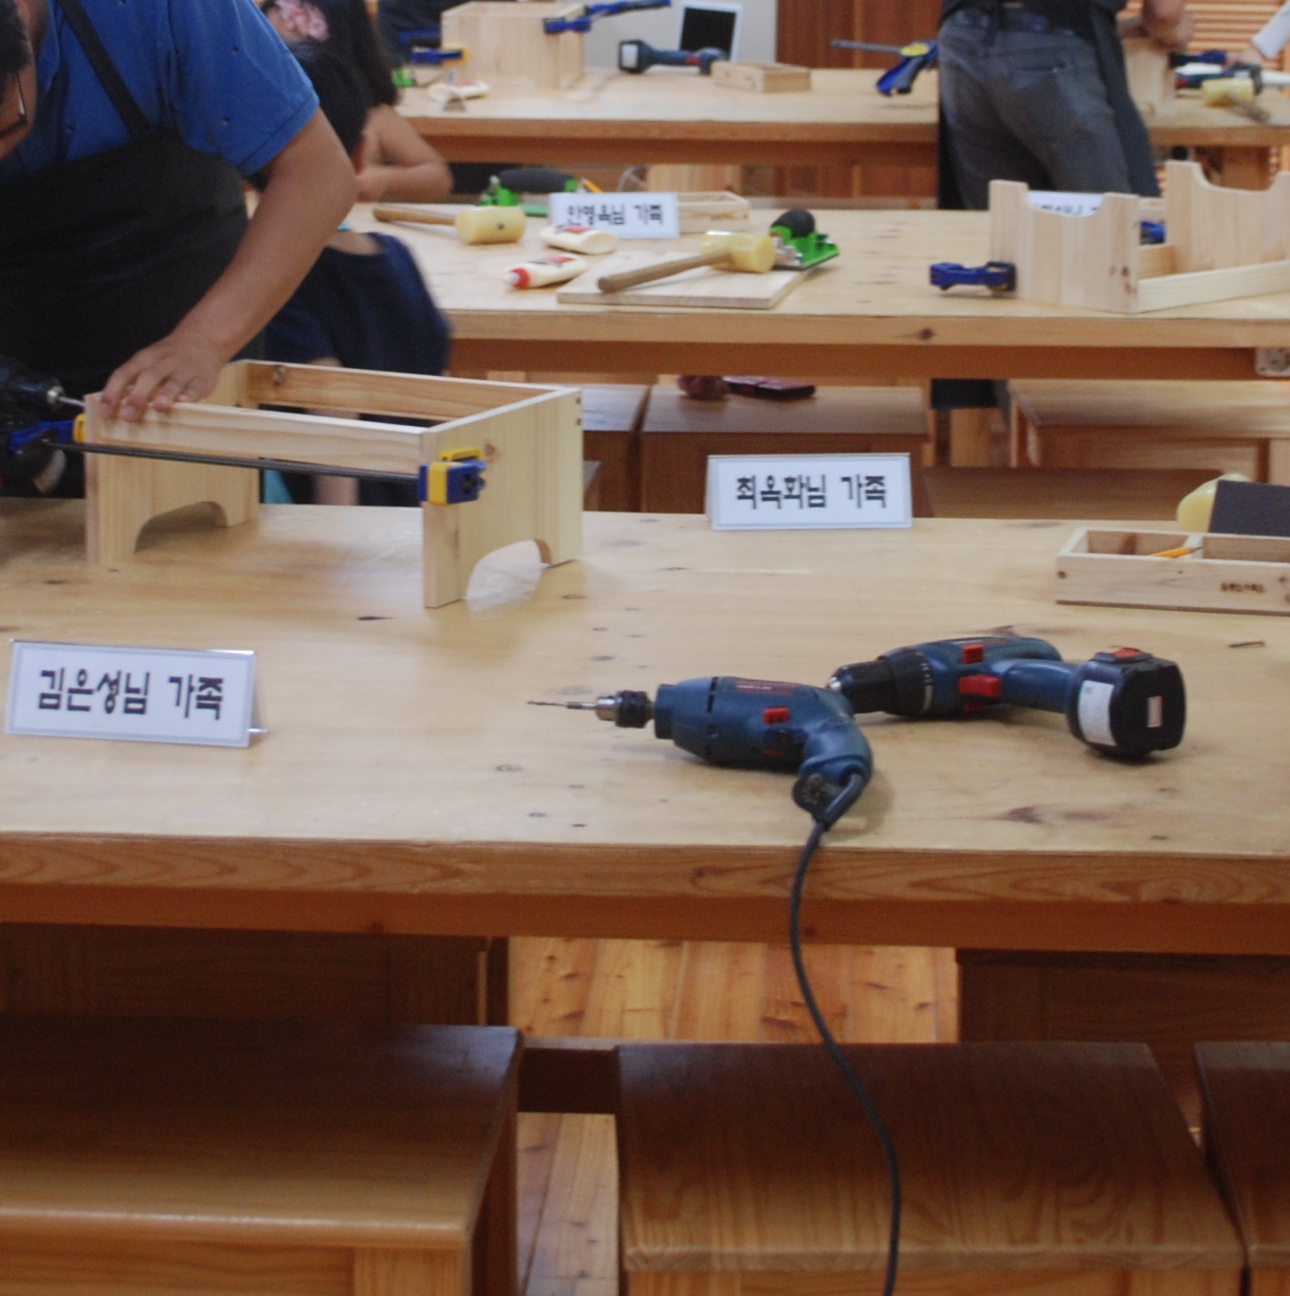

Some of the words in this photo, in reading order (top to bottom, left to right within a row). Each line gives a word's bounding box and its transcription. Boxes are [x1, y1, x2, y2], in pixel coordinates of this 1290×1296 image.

[736, 473, 827, 510] 최옥화님
[840, 473, 887, 509] 가족
[37, 666, 151, 715] 김은성님
[167, 673, 225, 721] 가족
